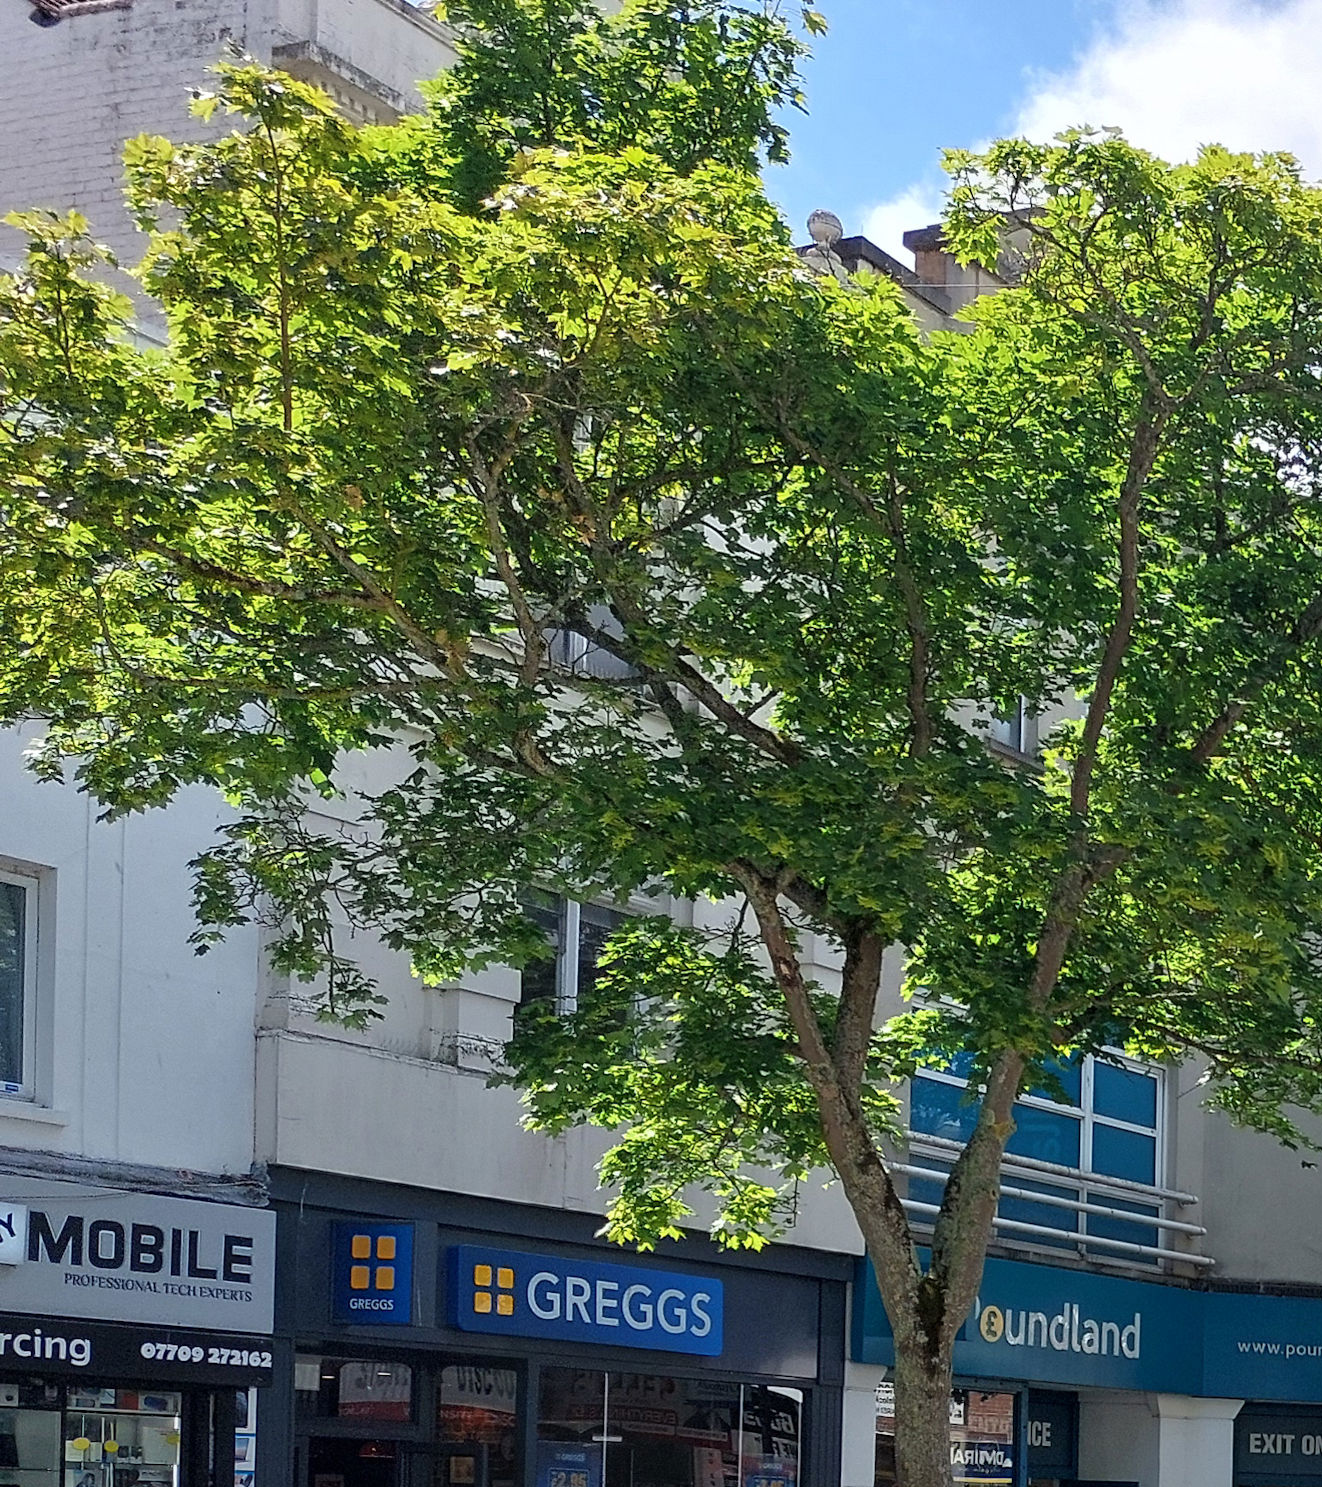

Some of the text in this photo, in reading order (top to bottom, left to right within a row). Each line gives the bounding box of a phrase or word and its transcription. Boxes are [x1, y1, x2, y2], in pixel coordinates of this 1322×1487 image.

[27, 1210, 254, 1284] MOBILE
[64, 1272, 253, 1302] PROFESSIONAL TECH EXPERTS
[349, 1298, 394, 1311] GREGGS
[527, 1271, 711, 1338] GREGGS
[140, 1342, 203, 1363] 07709
[207, 1347, 273, 1369] 272162
[1249, 1433, 1295, 1455] EXIT
